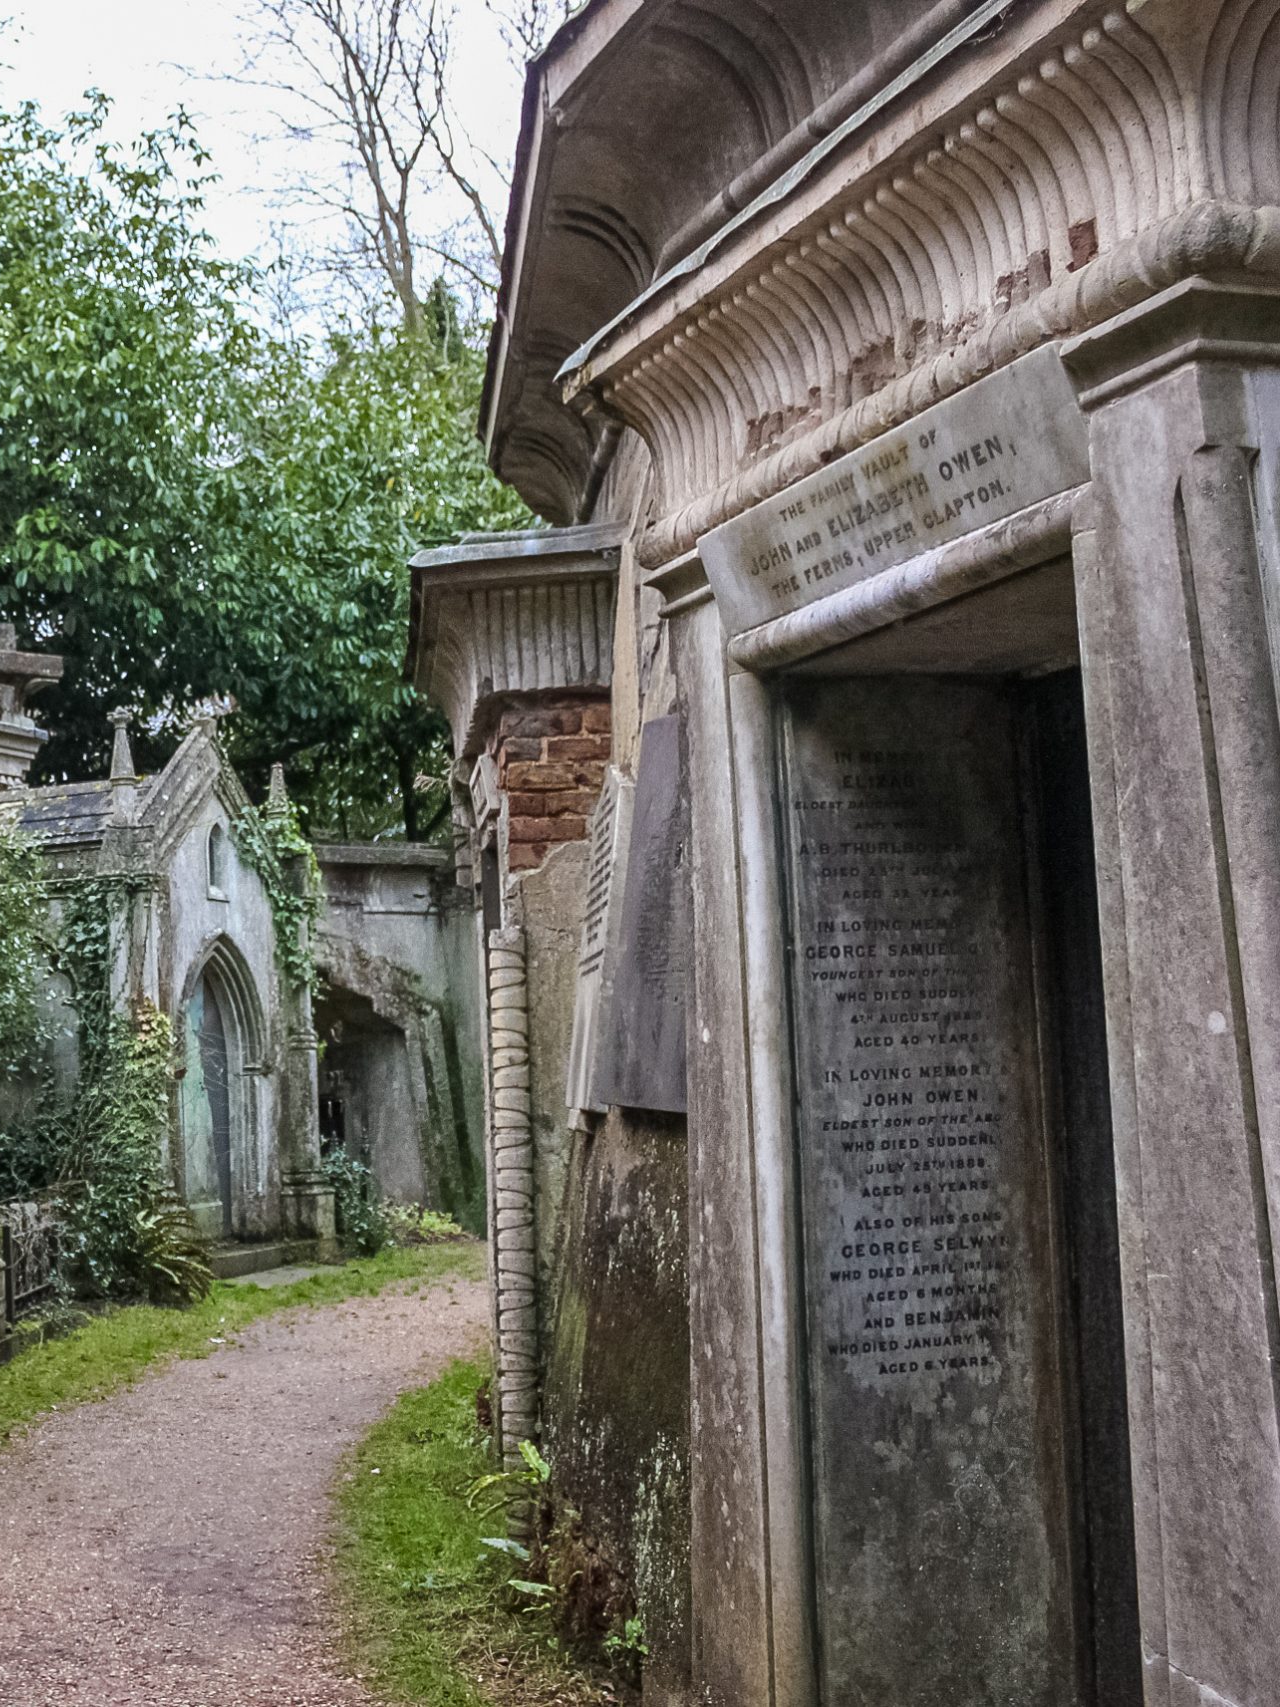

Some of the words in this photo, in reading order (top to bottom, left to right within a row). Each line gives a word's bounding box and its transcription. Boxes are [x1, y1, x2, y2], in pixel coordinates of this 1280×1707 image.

[779, 501, 806, 522] THE
[811, 472, 856, 508] FAMILY
[860, 444, 909, 480] VAULT
[919, 428, 936, 449] OF
[751, 541, 793, 576] JOHN
[796, 531, 822, 554] AND
[827, 472, 929, 538] ELIZABETH
[939, 435, 1017, 482] OWEN,
[772, 575, 800, 599] THE
[864, 521, 916, 557] UPPER
[923, 479, 1011, 529] CLAPTON.
[822, 866, 860, 878] DIED
[842, 889, 882, 901] AGED
[922, 887, 962, 900] YEAR
[818, 920, 835, 933] IN
[841, 919, 901, 933] LOVING
[910, 918, 961, 931] MEMO
[806, 944, 877, 960] GEORGE
[811, 968, 883, 981] YOUNGEST
[889, 967, 915, 979] SON
[922, 967, 938, 978] OF
[835, 991, 868, 1003] WHO
[873, 989, 911, 1002] DIED
[879, 1011, 939, 1024] AUGUST
[853, 1036, 895, 1049] AGED
[900, 1035, 920, 1046] 40
[824, 1069, 841, 1084] IN
[849, 1067, 912, 1082] LOVING
[862, 1092, 914, 1108] JOHN
[822, 1119, 879, 1132] ELDEST
[884, 1117, 913, 1128] SON
[917, 1115, 935, 1127] OF
[941, 1114, 968, 1125] THE
[841, 1141, 876, 1154] WHO
[880, 1138, 920, 1152] DIED
[864, 1162, 906, 1176] JULY
[861, 1185, 904, 1199] AGED
[853, 1216, 895, 1232] ALSO
[902, 1216, 921, 1229] OF
[929, 1213, 955, 1226] HIS
[961, 1211, 1002, 1224] SONS
[841, 1239, 922, 1260] GEORGE
[933, 1235, 1010, 1253] SELWYN
[829, 1269, 862, 1282] WHO
[868, 1266, 906, 1280] DIED
[912, 1262, 957, 1276] APRIL
[866, 1289, 909, 1304] AGED
[915, 1287, 926, 1300] 6
[931, 1282, 998, 1299] MONTHS
[863, 1316, 896, 1330] AND
[904, 1305, 1000, 1328] BENJAMIN
[827, 1342, 860, 1357] WHO
[862, 1339, 899, 1354] DIED
[903, 1334, 974, 1351] JANUARY
[878, 1360, 920, 1376] AGED
